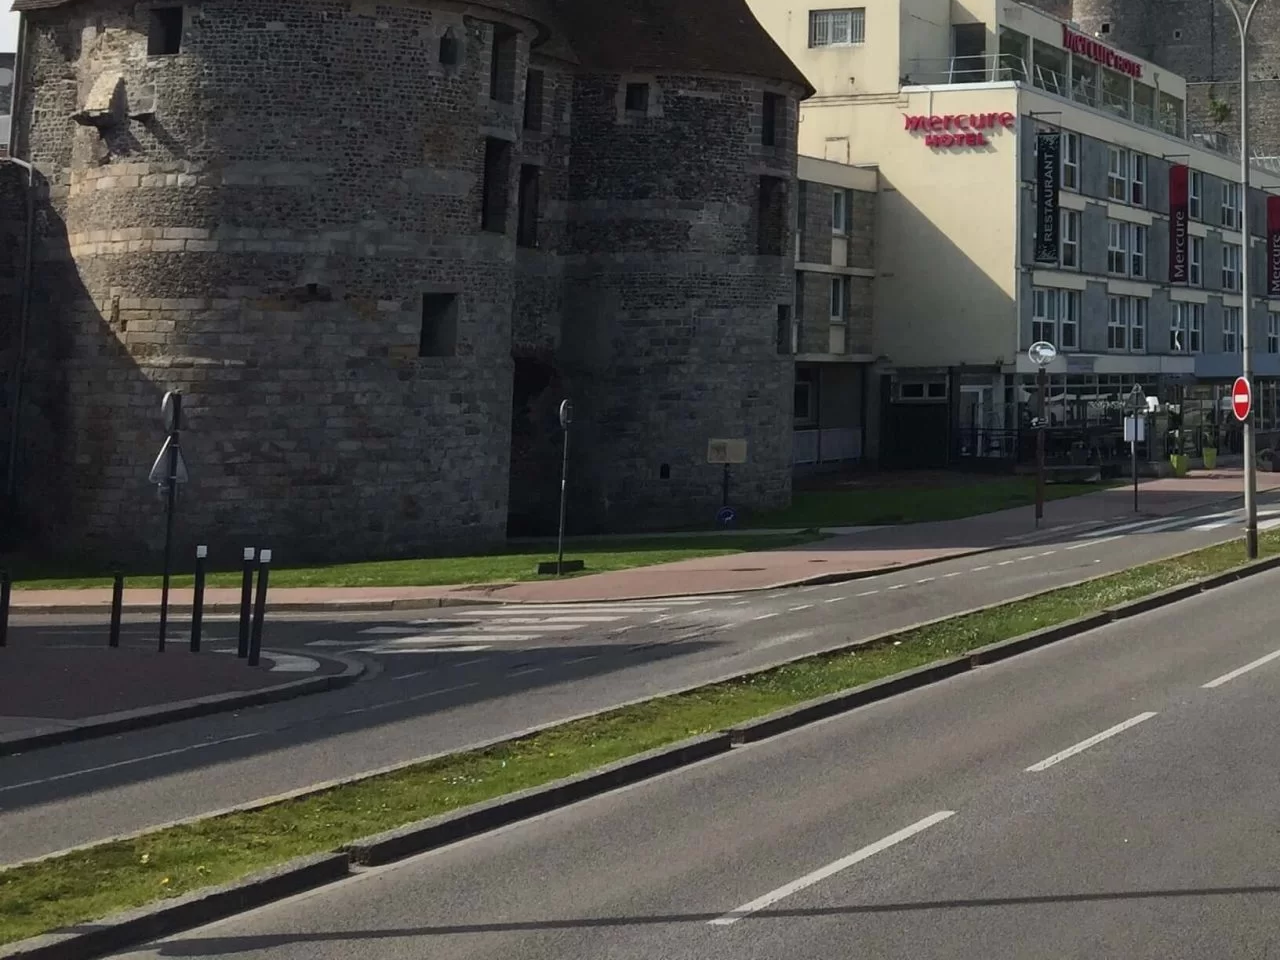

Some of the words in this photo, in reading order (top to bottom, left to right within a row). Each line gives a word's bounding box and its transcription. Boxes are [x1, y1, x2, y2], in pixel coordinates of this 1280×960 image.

[925, 133, 988, 147] HOTEL
[1044, 152, 1053, 242] RESTAURANT
[1174, 211, 1184, 278] Mercure
[1272, 234, 1280, 291] Mercure
